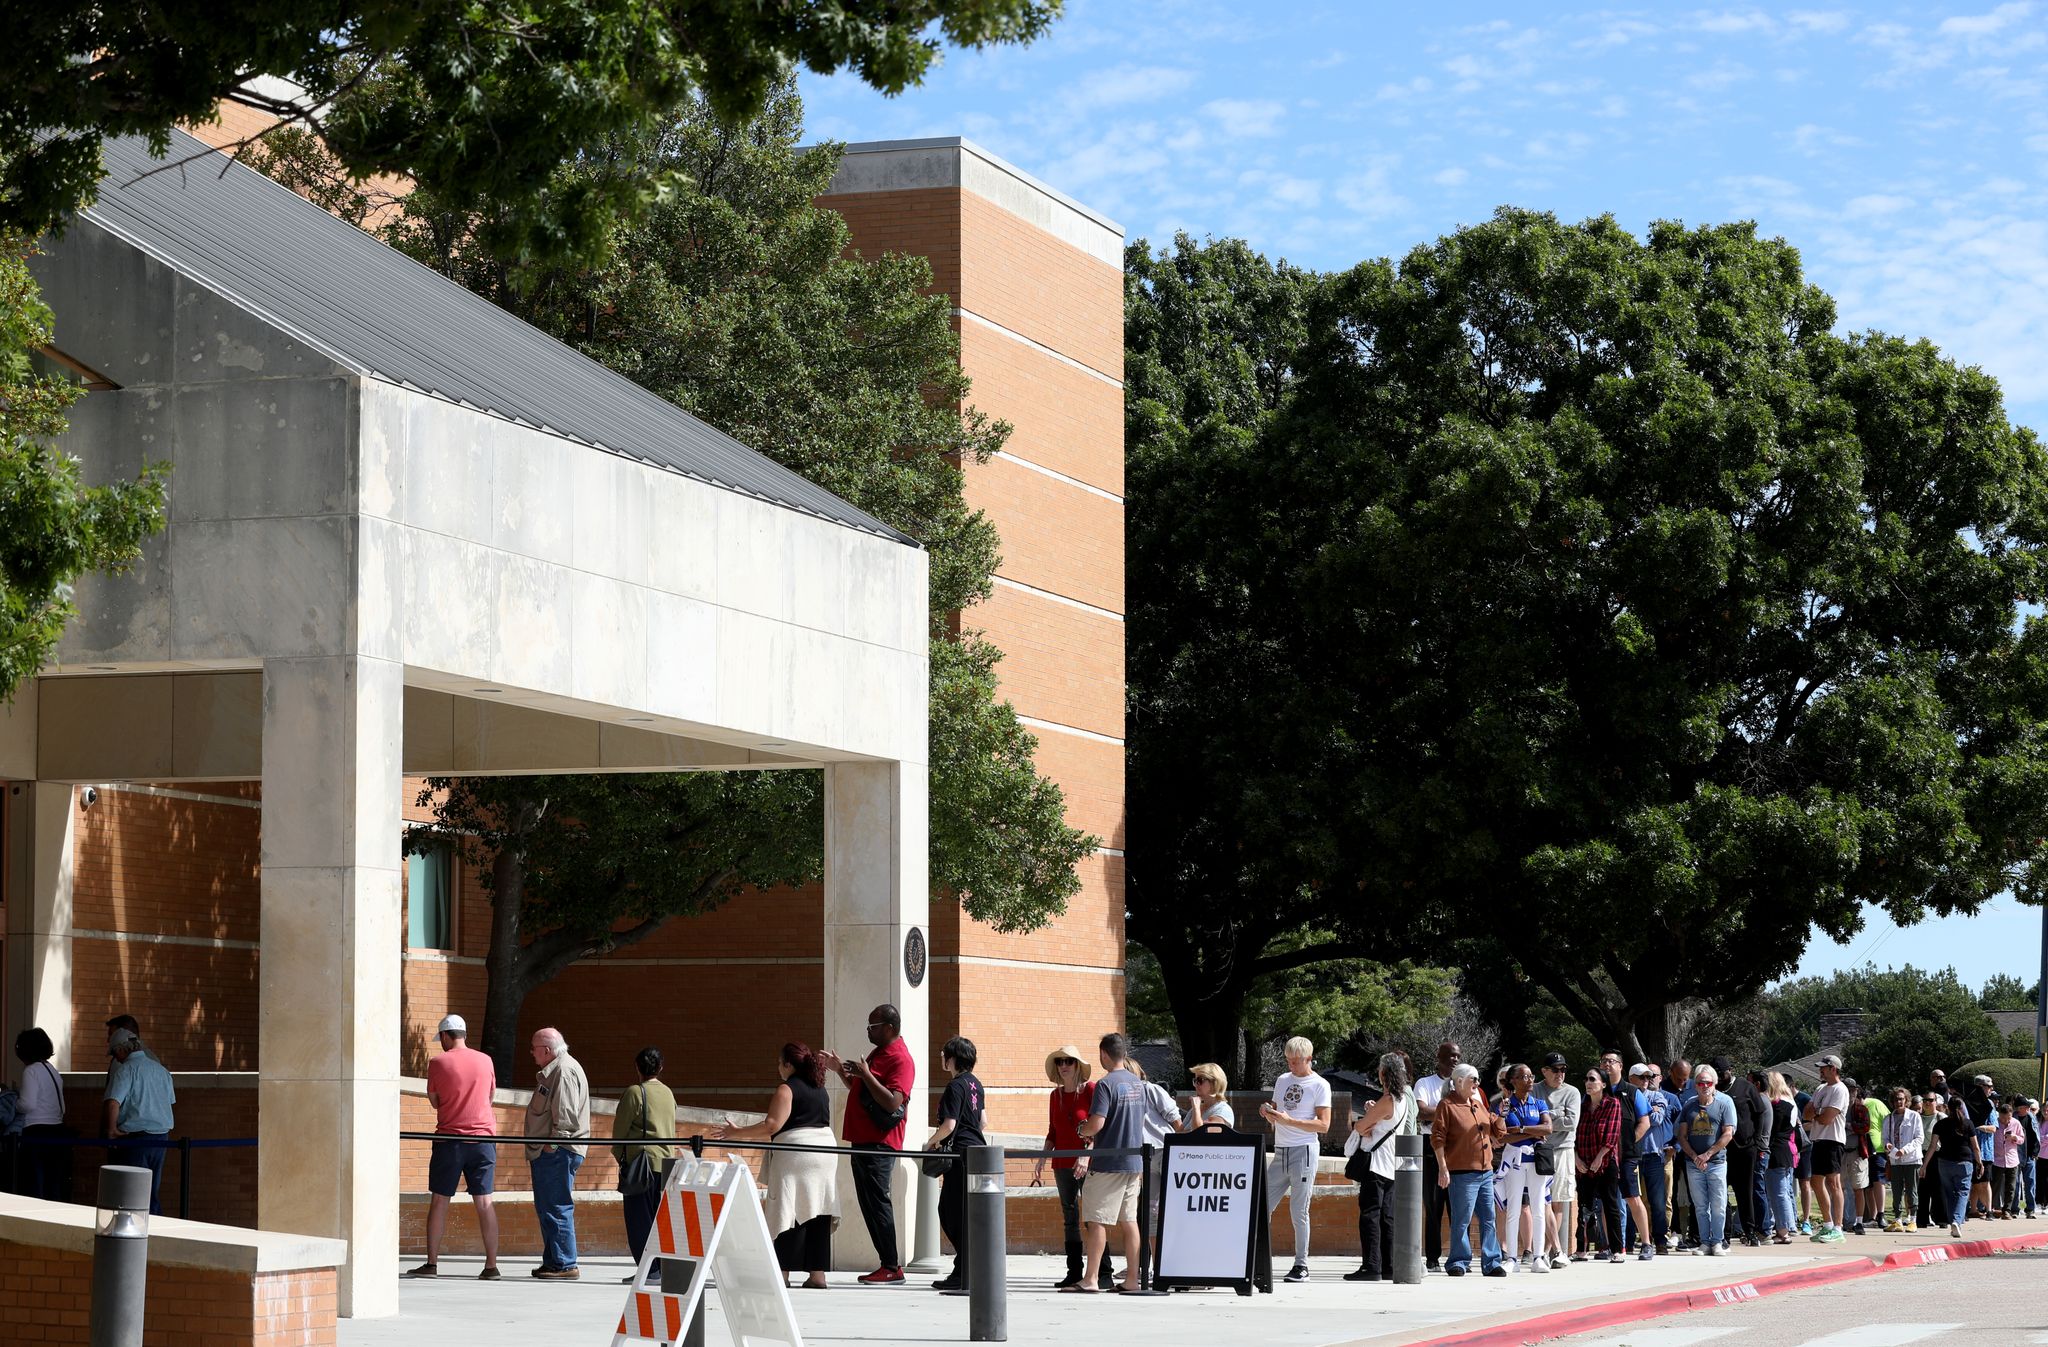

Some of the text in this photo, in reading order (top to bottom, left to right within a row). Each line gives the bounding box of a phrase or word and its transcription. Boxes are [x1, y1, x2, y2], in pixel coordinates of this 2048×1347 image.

[1186, 1152, 1203, 1160] Plano
[1225, 1153, 1246, 1161] Library
[1173, 1172, 1247, 1190] VOTING
[1187, 1195, 1230, 1212] LINE
